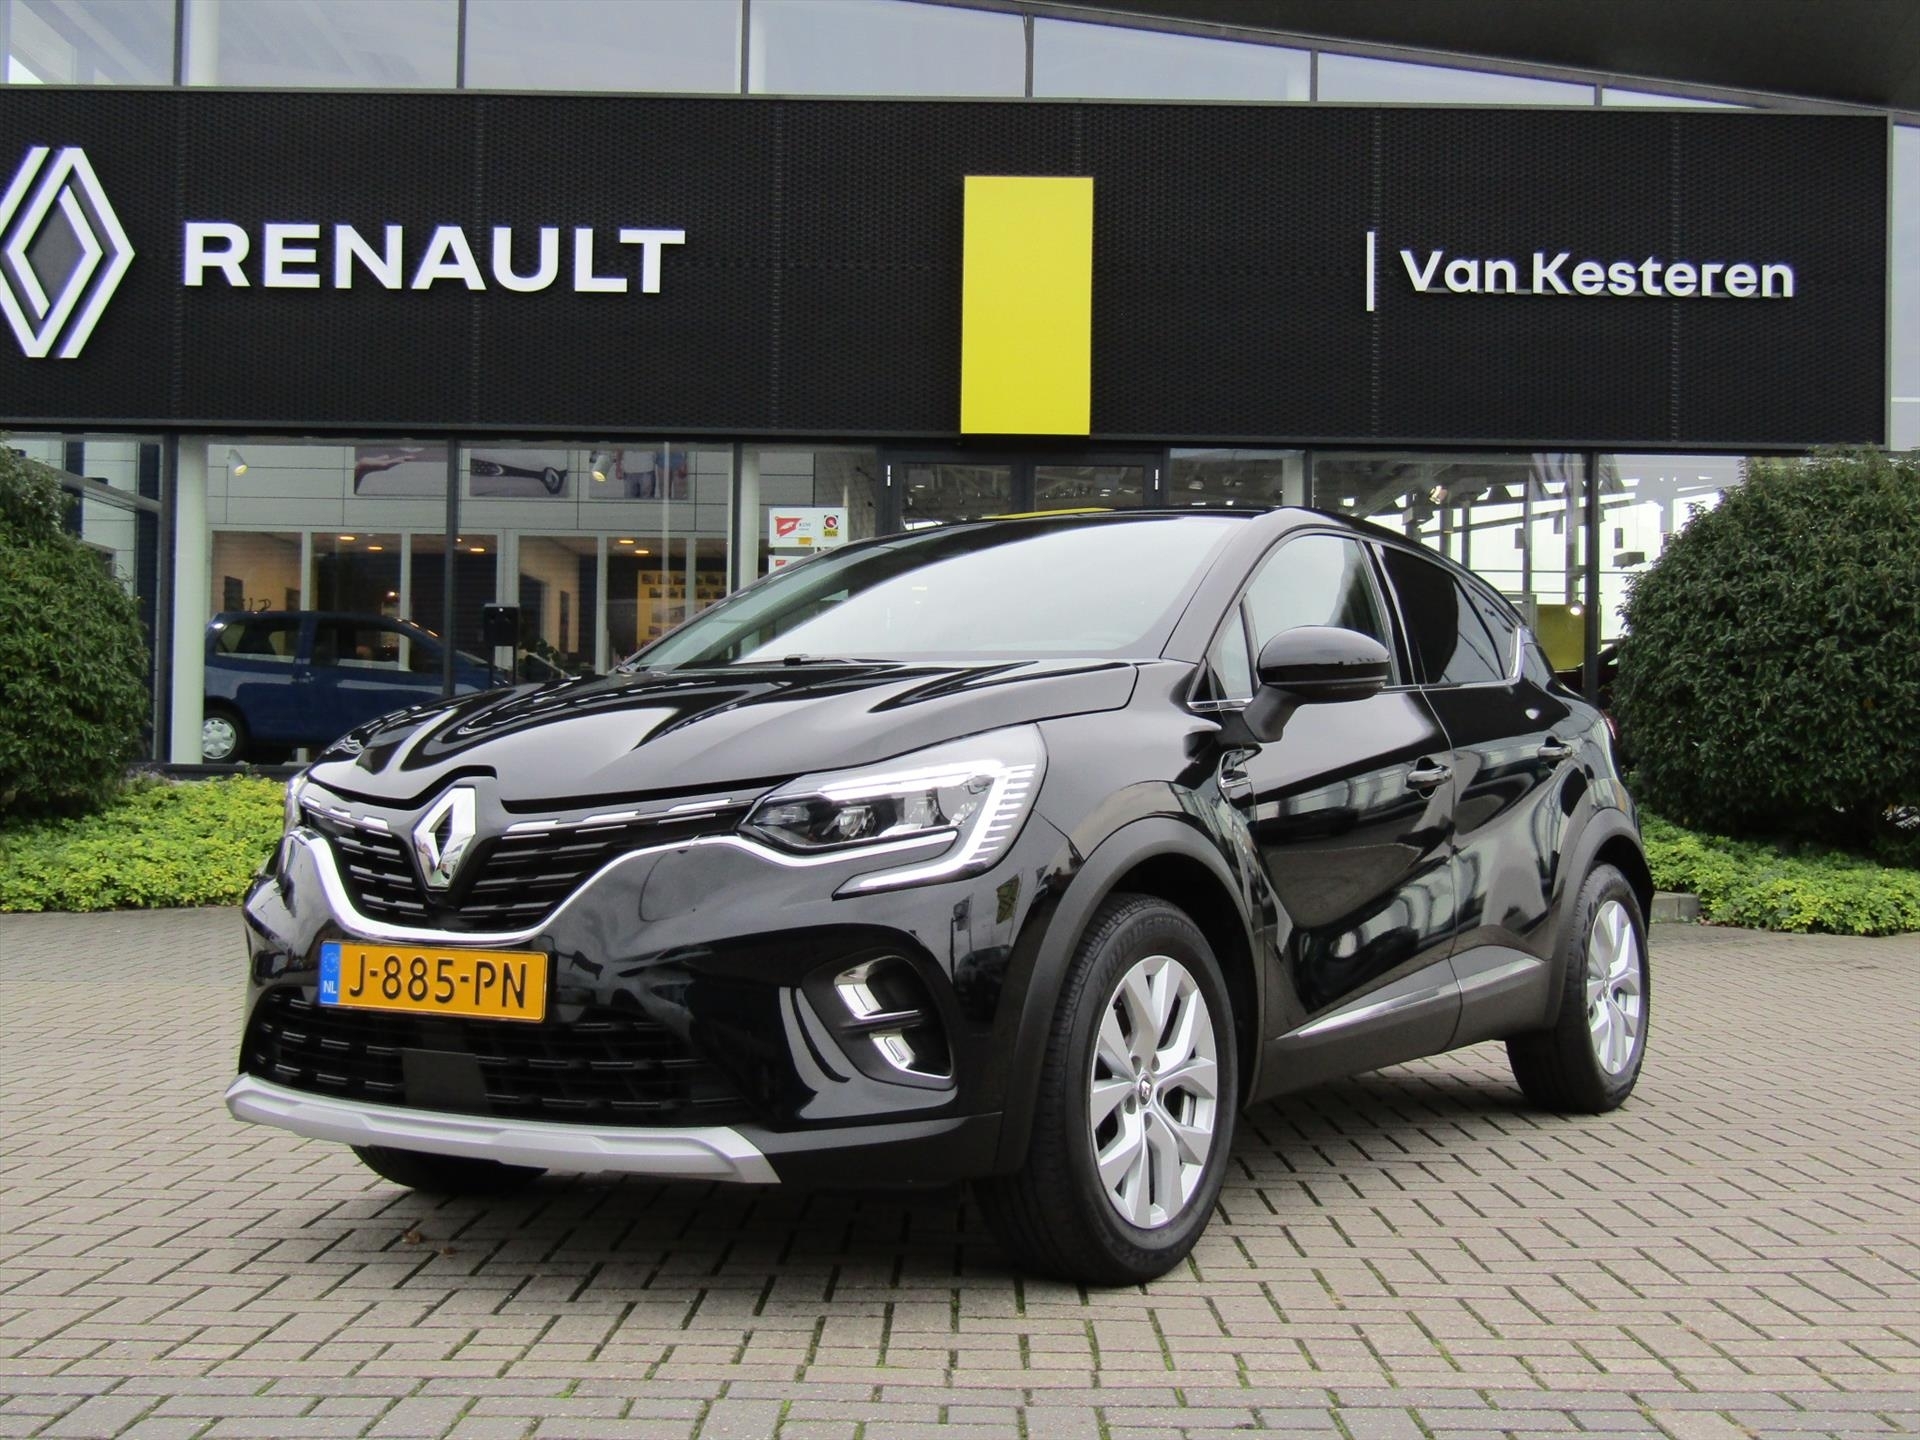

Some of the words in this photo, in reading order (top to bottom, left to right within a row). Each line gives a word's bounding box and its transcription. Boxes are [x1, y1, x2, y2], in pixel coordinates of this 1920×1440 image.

[184, 222, 686, 293] RENAULT
[1400, 250, 1516, 293] Van
[1532, 252, 1794, 298] Kesteren
[323, 980, 337, 994] NL
[349, 953, 527, 1009] J-885-PN
